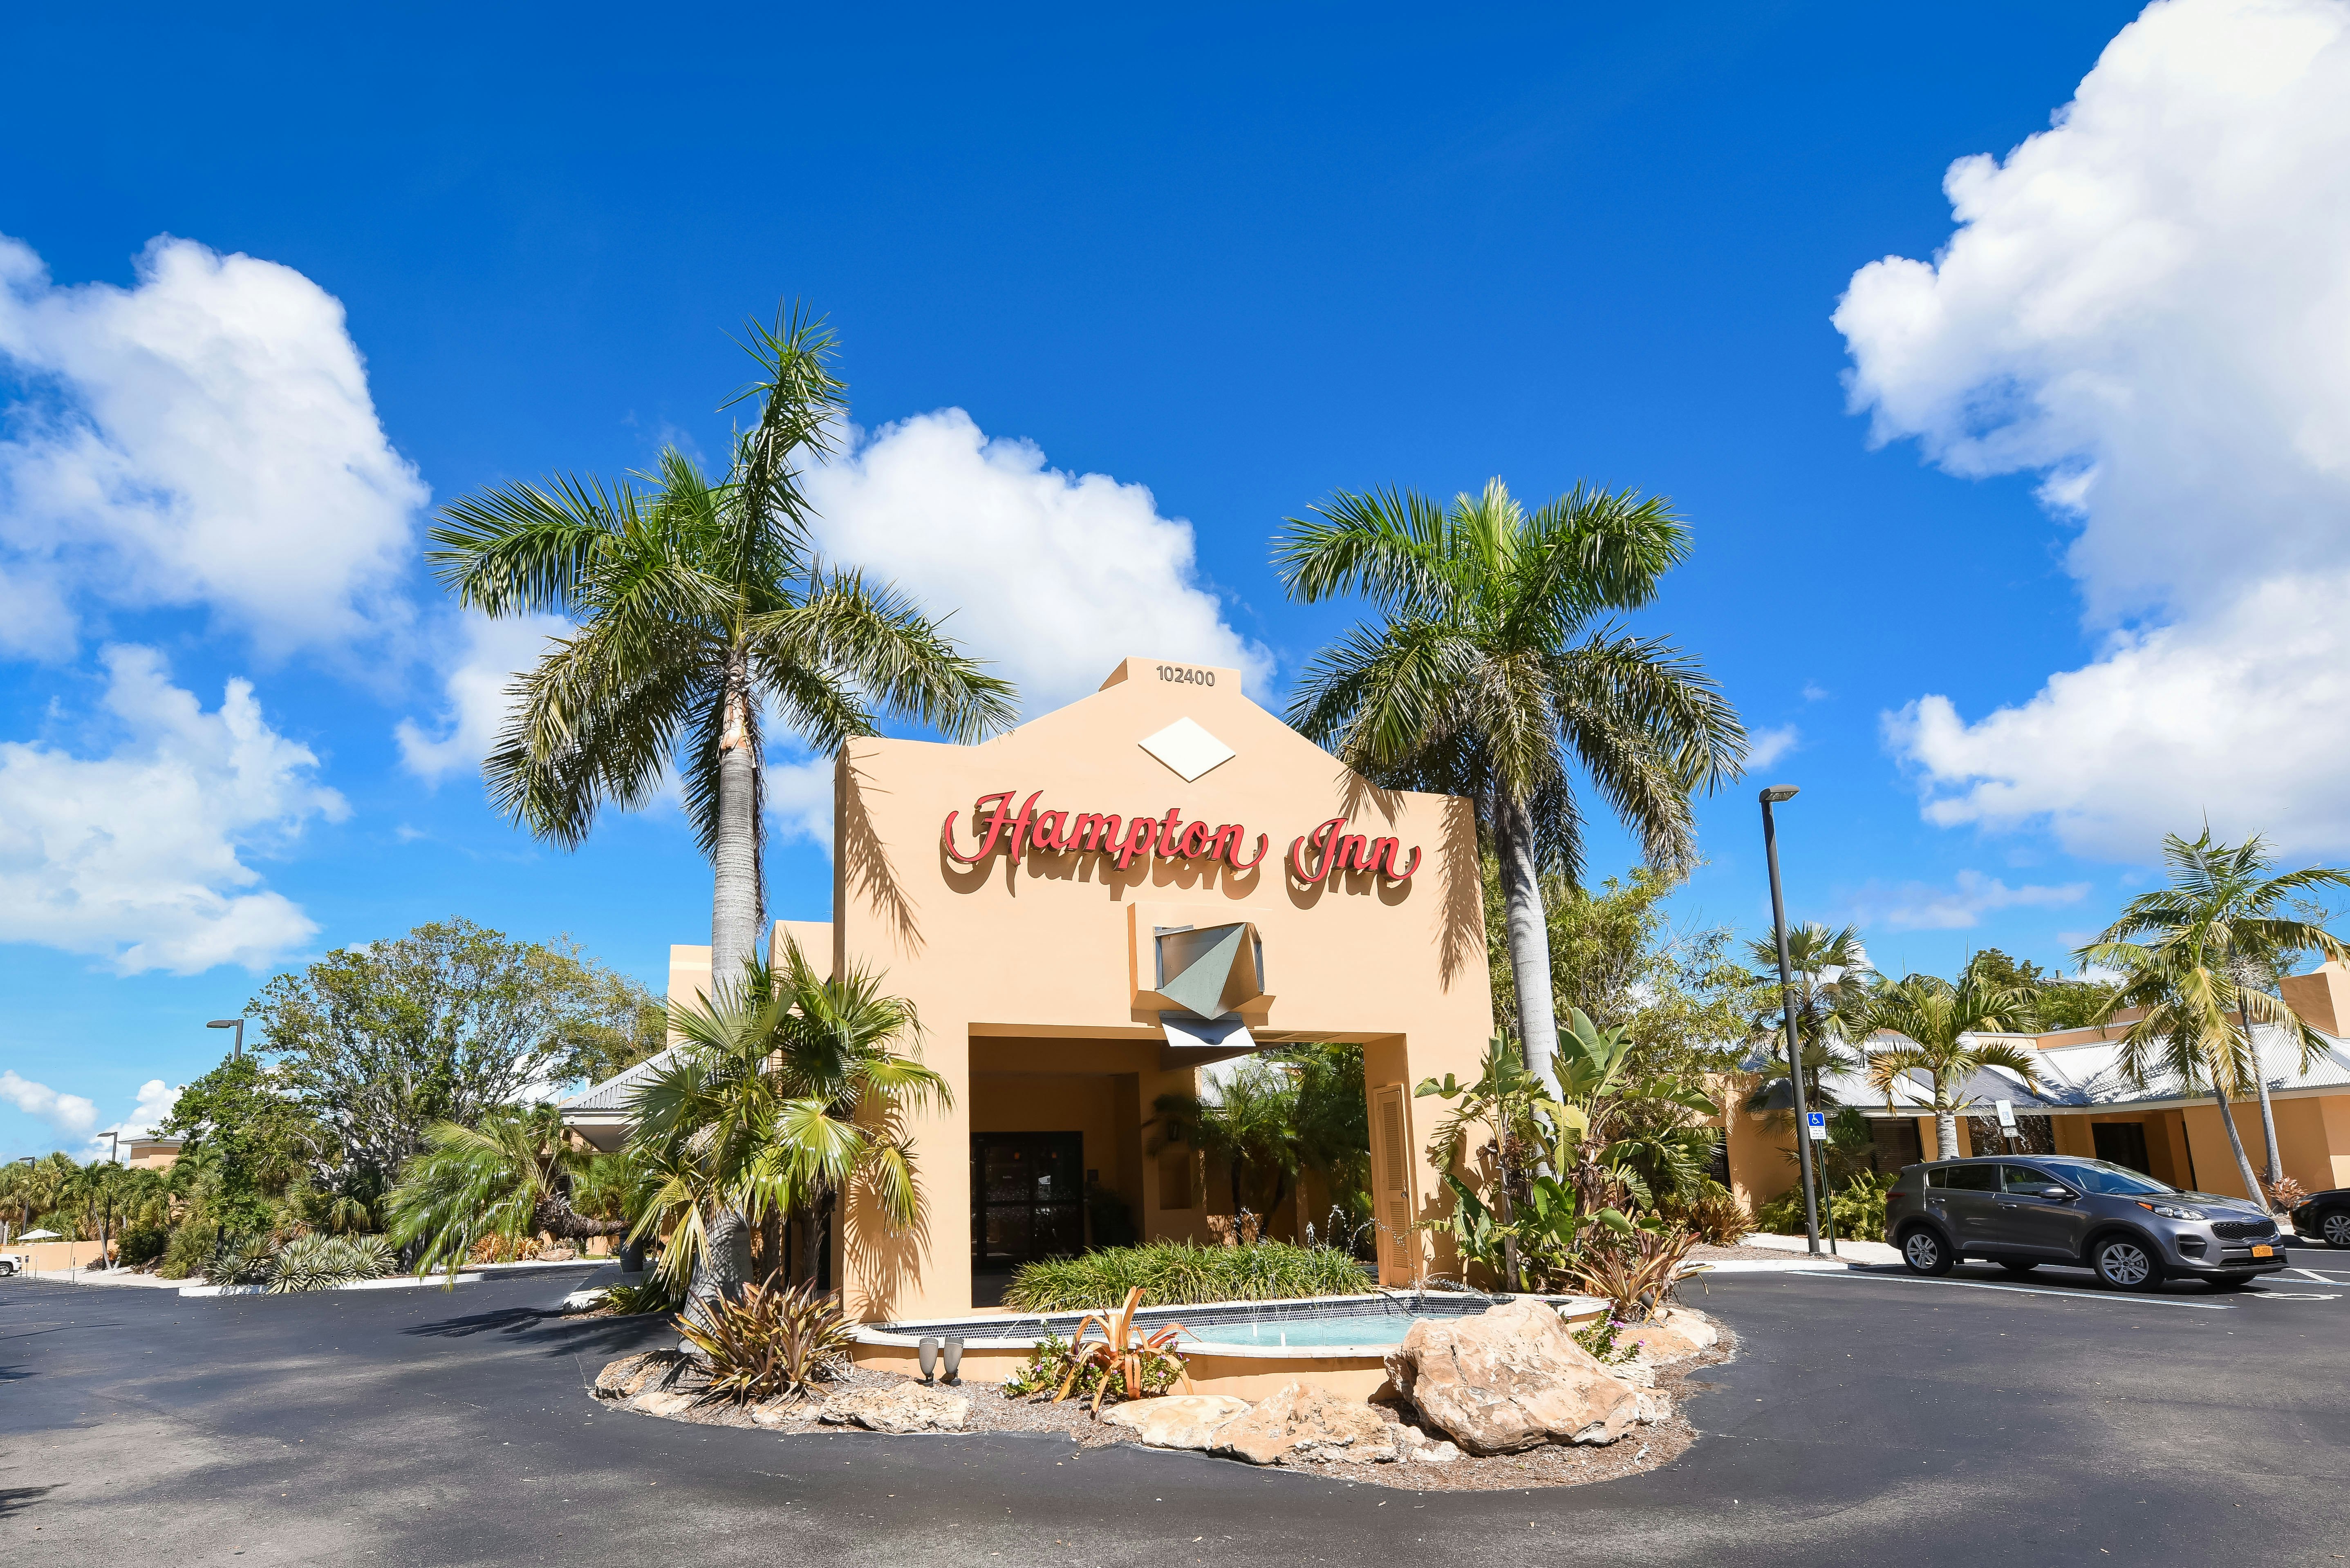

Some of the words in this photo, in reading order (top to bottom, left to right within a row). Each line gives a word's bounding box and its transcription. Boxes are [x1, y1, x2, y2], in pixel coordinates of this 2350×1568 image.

[1156, 665, 1215, 687] 102400
[942, 790, 1268, 872] Hampton
[1288, 818, 1421, 884] Inn
